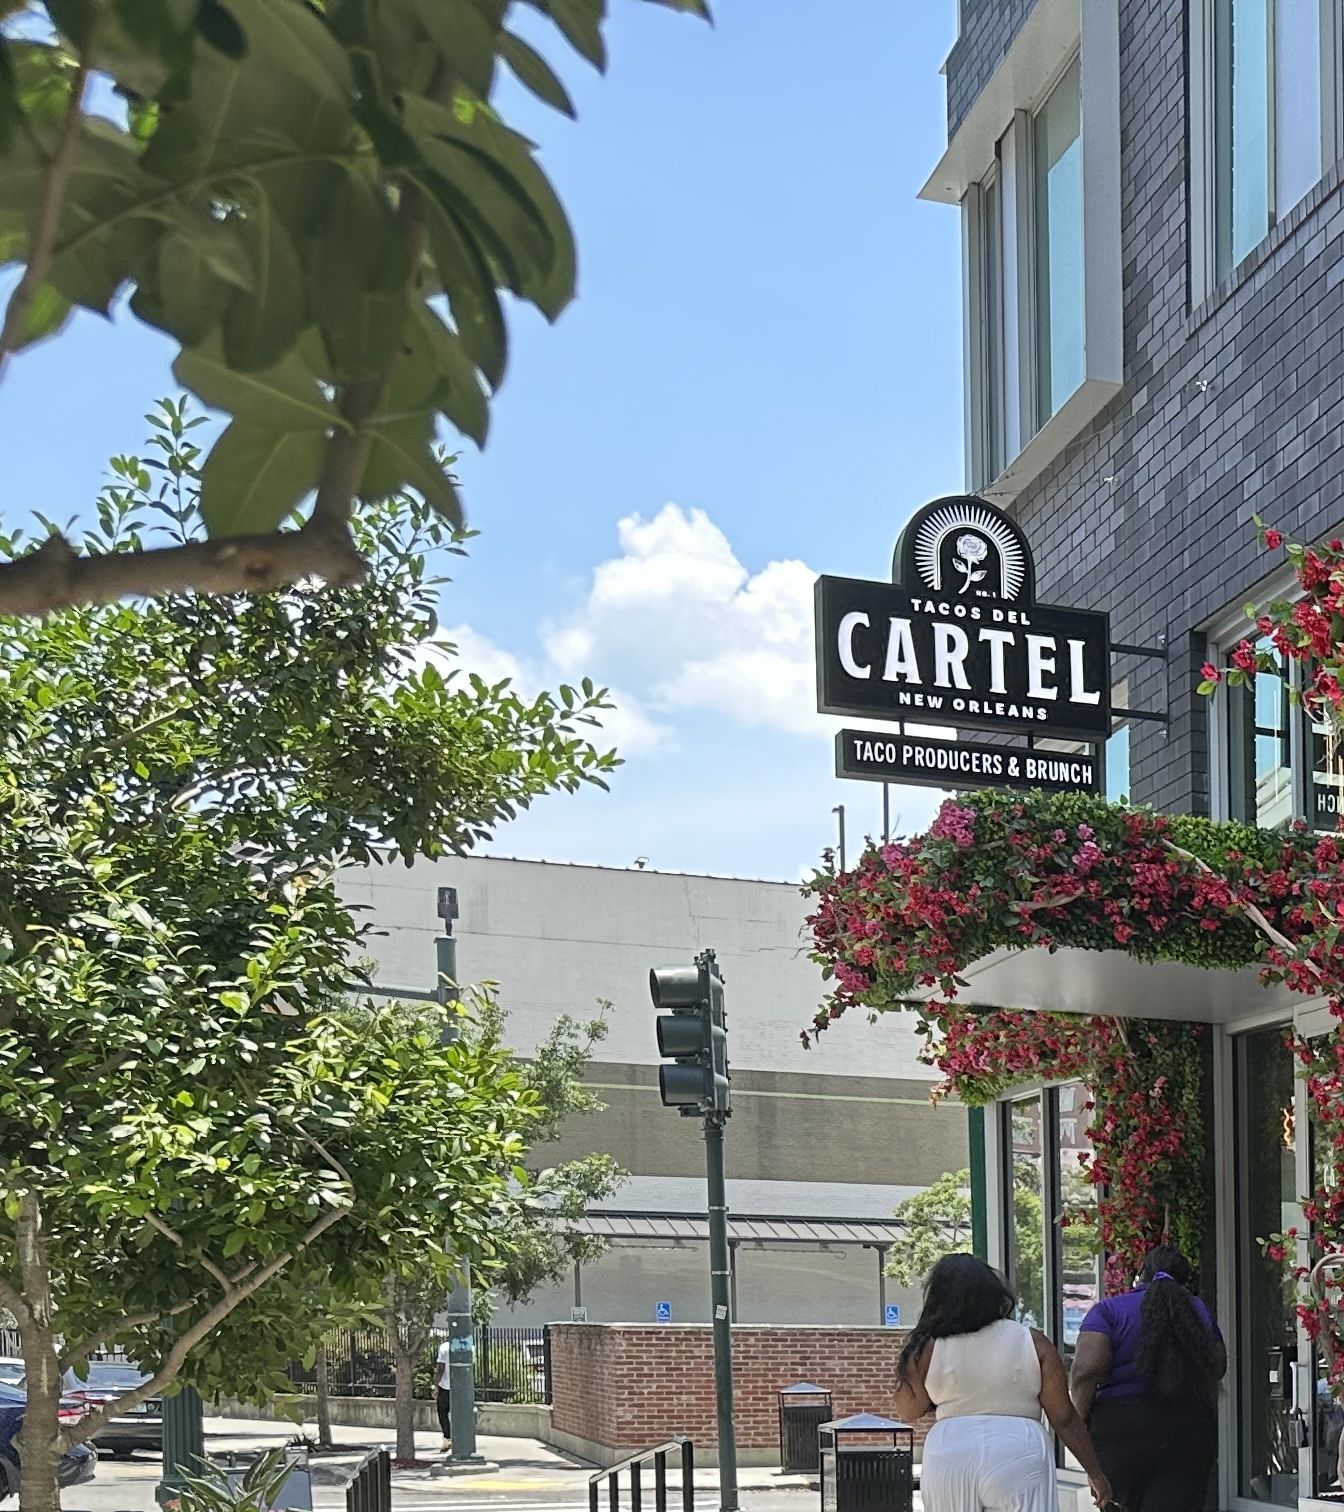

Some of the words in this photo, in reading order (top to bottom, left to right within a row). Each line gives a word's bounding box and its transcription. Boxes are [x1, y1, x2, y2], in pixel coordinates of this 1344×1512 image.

[910, 598, 981, 620] TACOS
[992, 608, 1031, 626] DEL
[837, 611, 1101, 705] CARTEL
[899, 691, 944, 709] NEW
[952, 698, 1048, 721] ORLEANS
[853, 739, 896, 764] TACO
[902, 744, 1003, 775] PRODUCERS
[1007, 756, 1020, 777] &
[1026, 758, 1092, 785] BRUNCH
